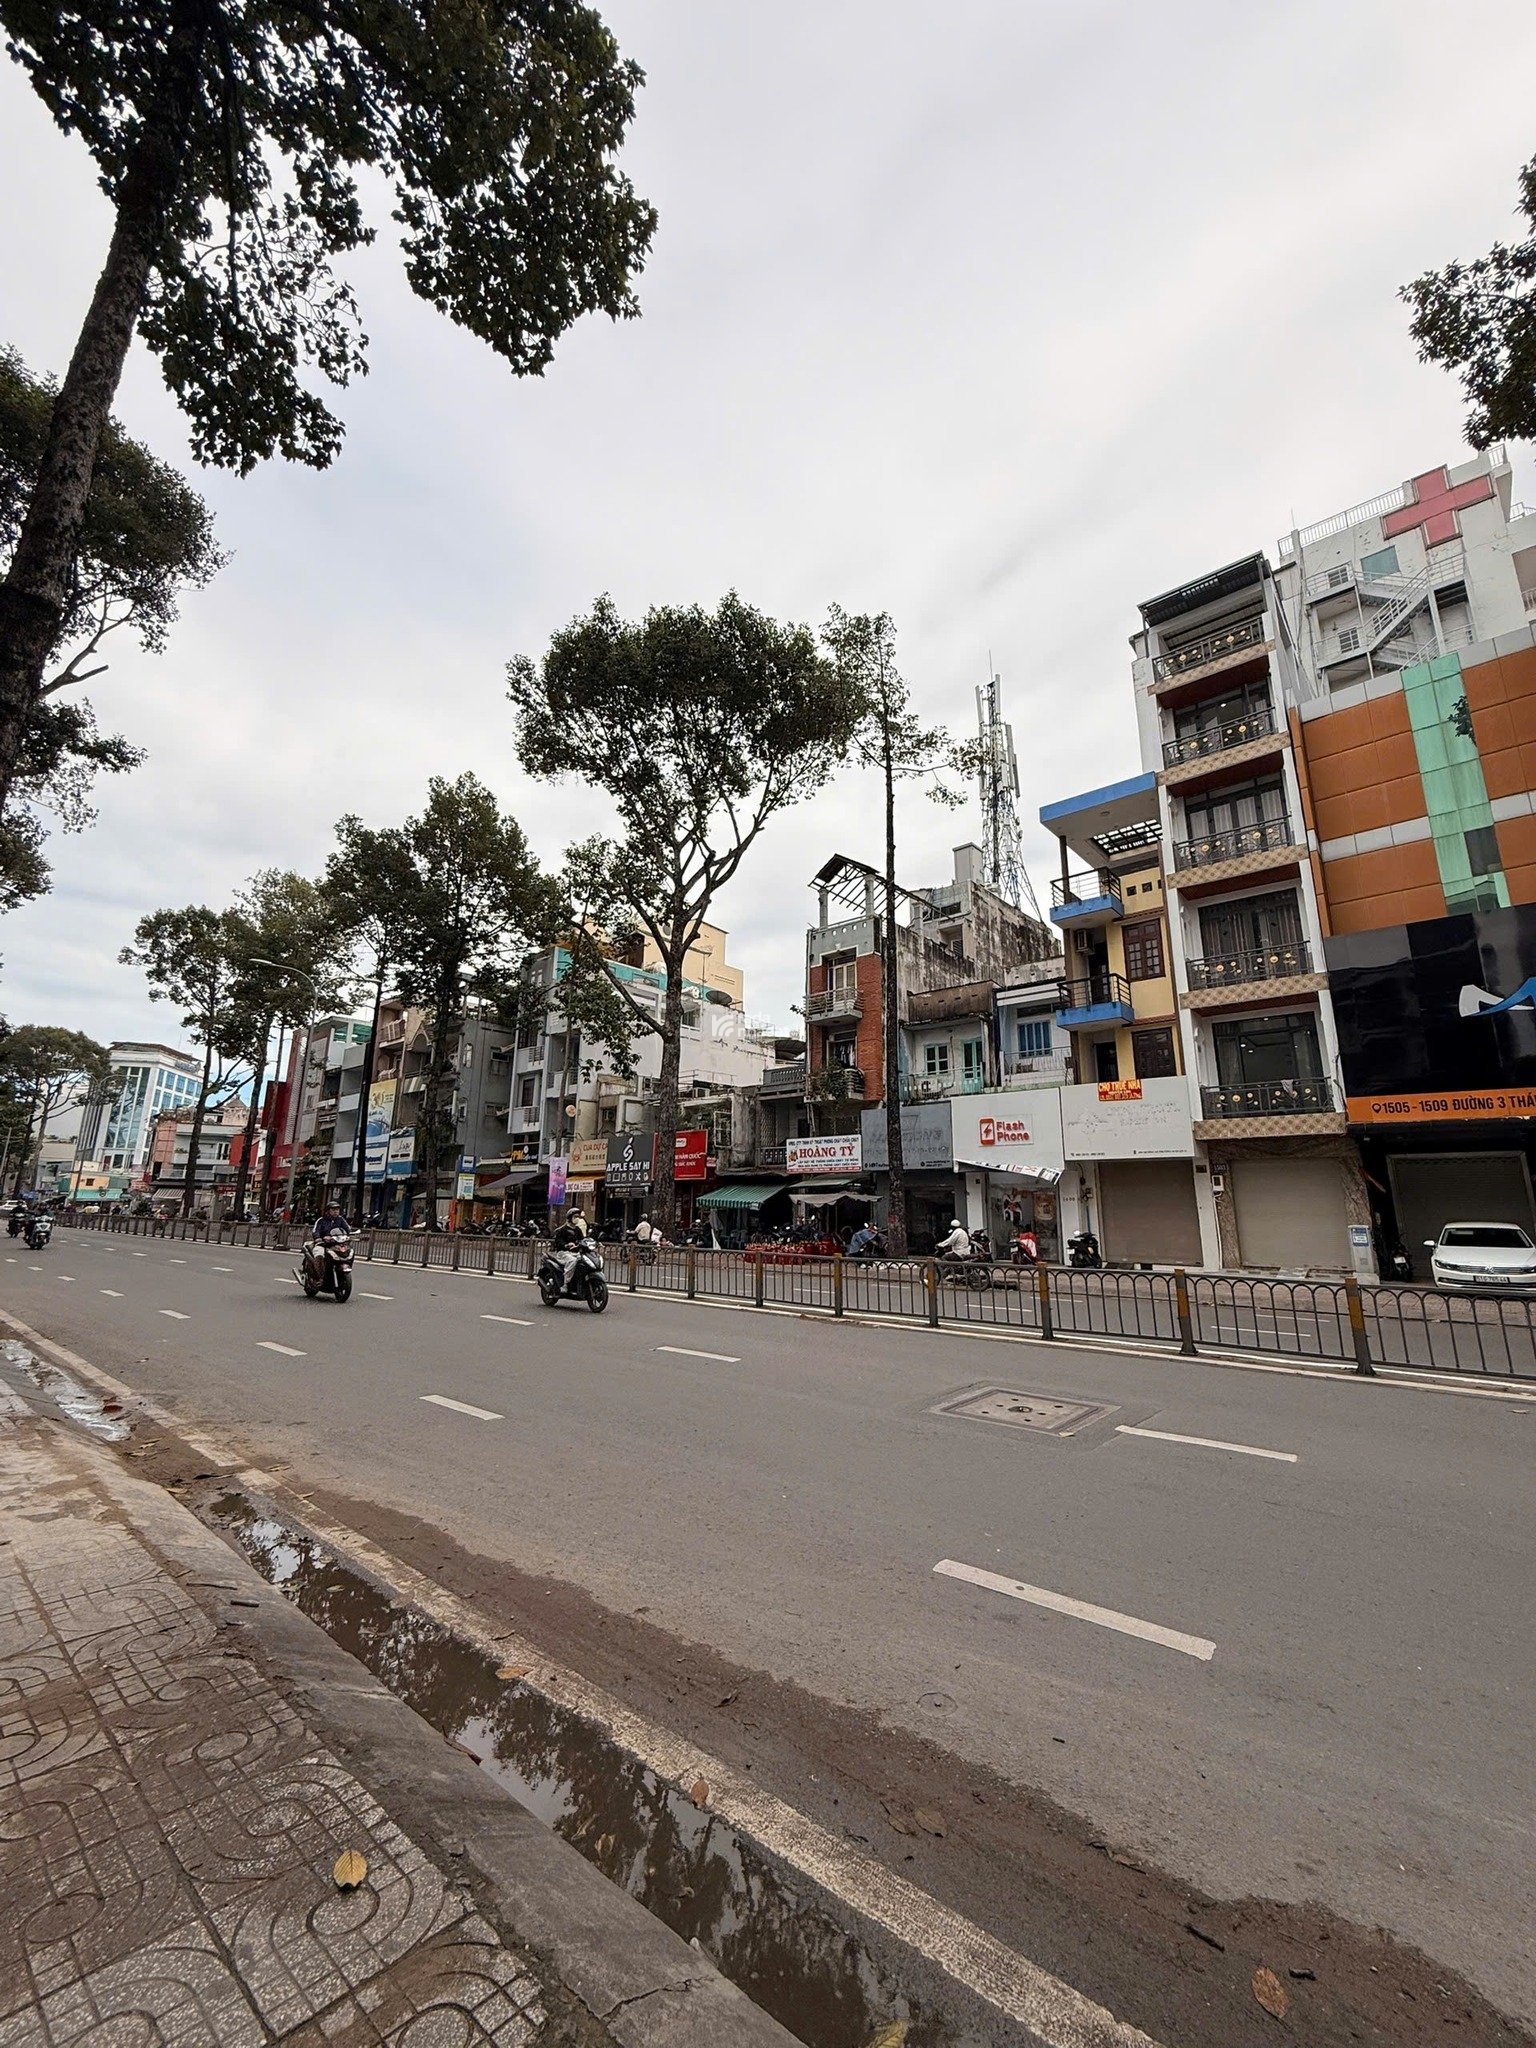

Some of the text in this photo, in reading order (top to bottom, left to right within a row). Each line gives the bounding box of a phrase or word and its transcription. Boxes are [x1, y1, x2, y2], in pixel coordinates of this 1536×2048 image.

[1383, 1101, 1411, 1114] 1505
[1419, 1099, 1449, 1113] 1509
[1452, 1095, 1494, 1110] ĐƯỜNG
[1497, 1096, 1506, 1108] 3
[1508, 1092, 1536, 1108] THÁ
[996, 1120, 1025, 1131] Flash
[997, 1131, 1030, 1142] Phone
[799, 1145, 837, 1159] HOÀNG
[606, 1162, 628, 1172] APPLE
[629, 1162, 642, 1171] SAY
[643, 1161, 650, 1170] HI
